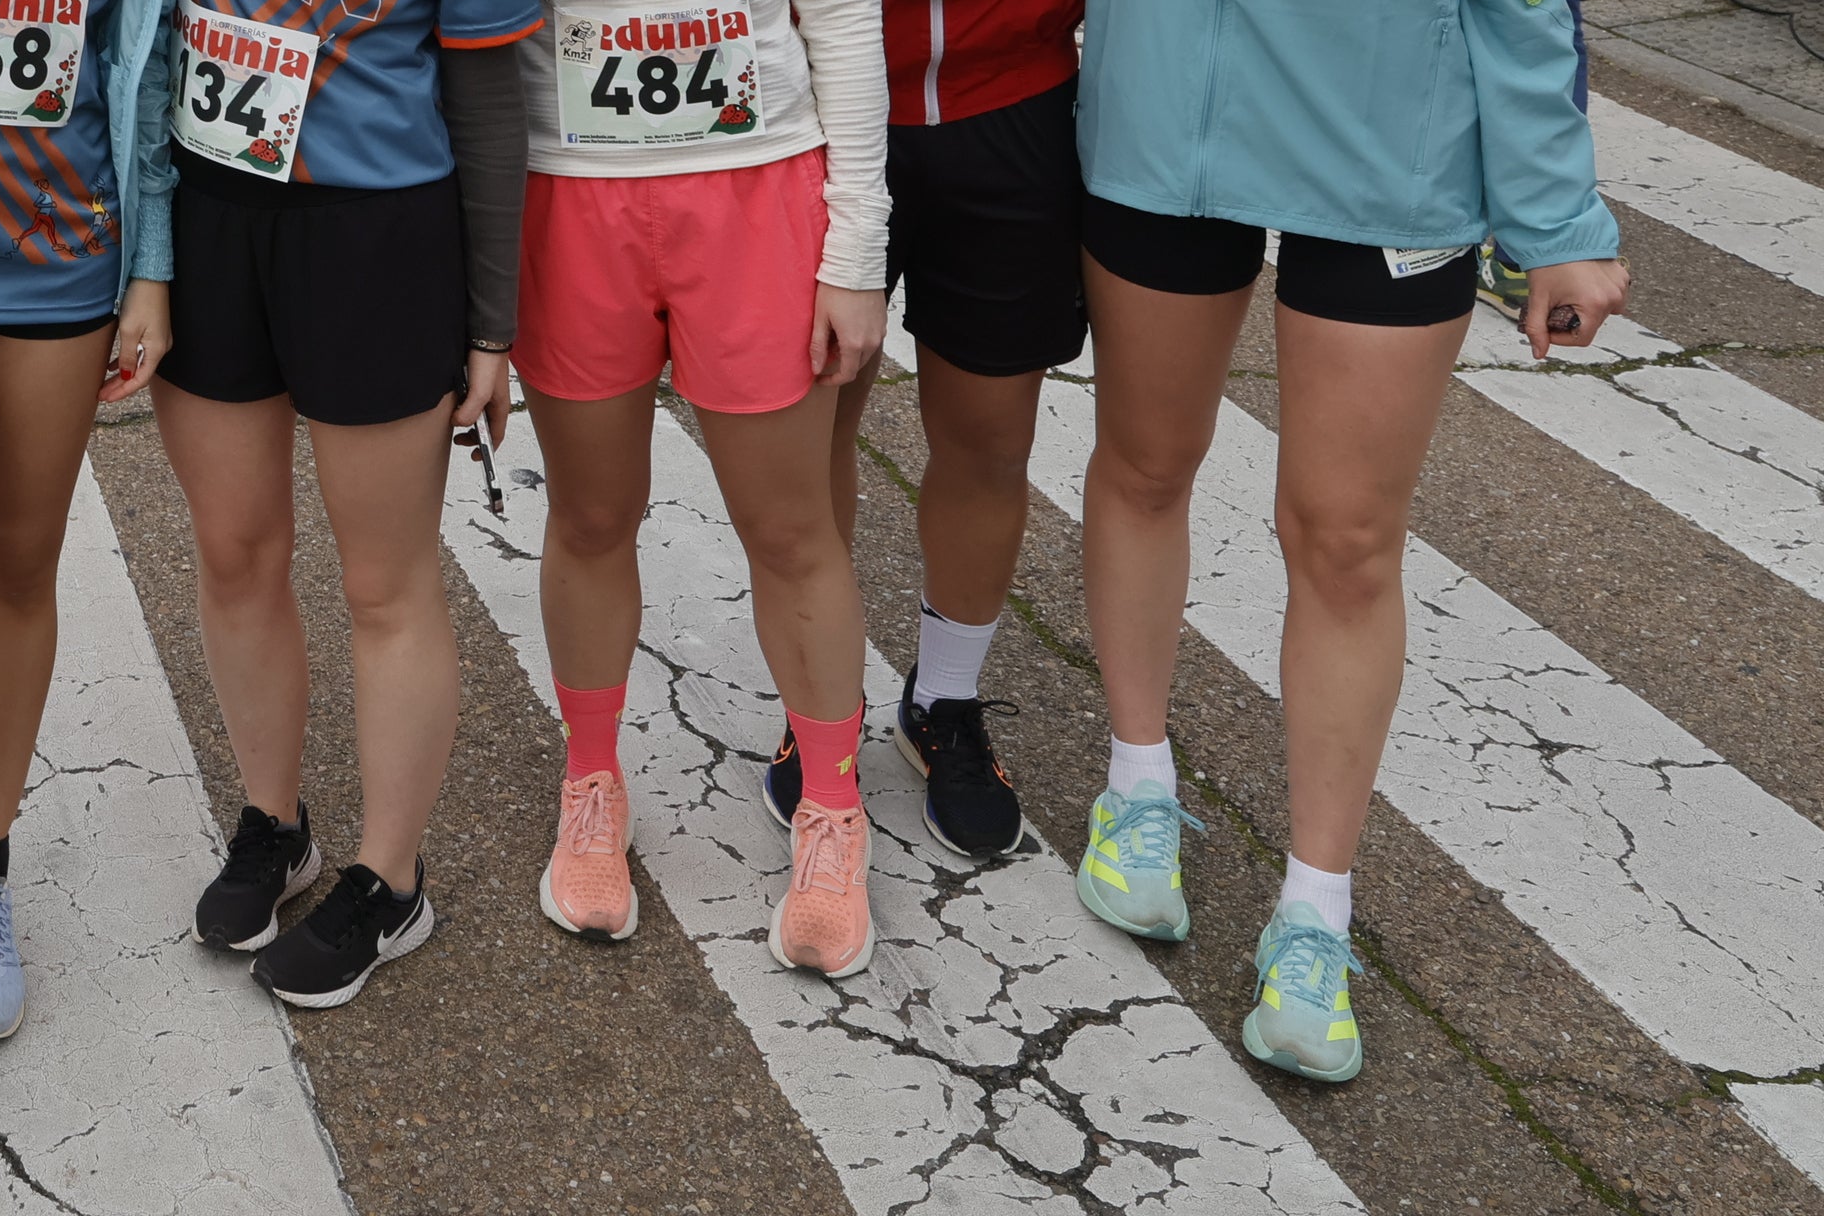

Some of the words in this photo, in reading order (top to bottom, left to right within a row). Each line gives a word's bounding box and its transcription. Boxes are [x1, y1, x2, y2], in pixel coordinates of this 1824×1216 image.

[644, 7, 704, 21] FLORISTERÍAS
[210, 18, 267, 39] FLORISTERÍAS
[563, 47, 592, 61] Km21
[178, 47, 268, 138] 134
[591, 48, 729, 116] 484
